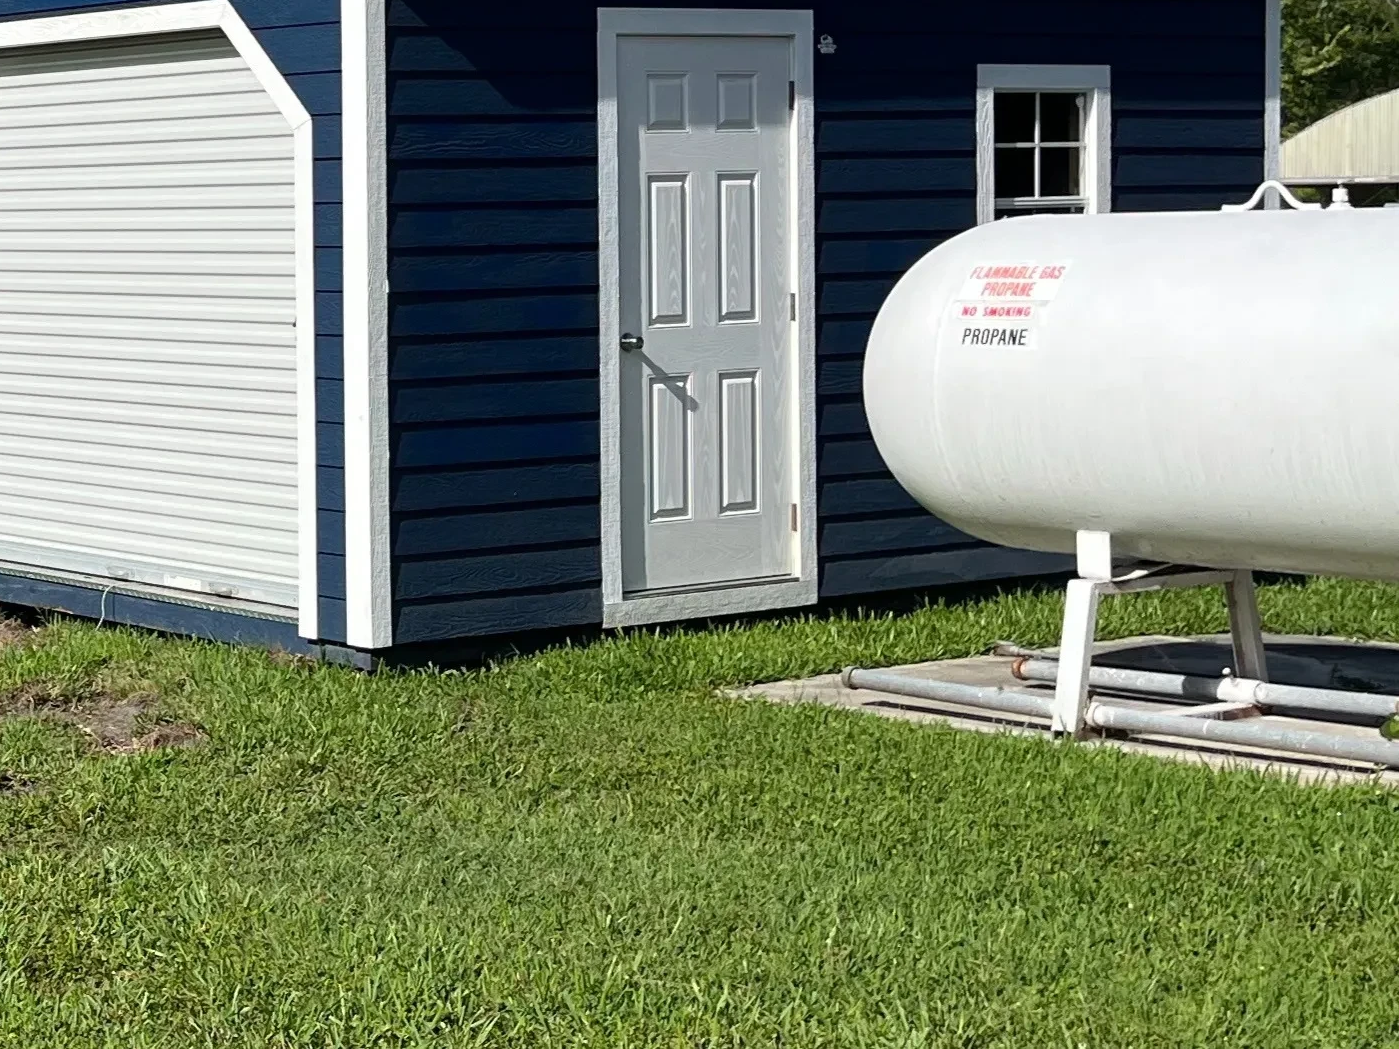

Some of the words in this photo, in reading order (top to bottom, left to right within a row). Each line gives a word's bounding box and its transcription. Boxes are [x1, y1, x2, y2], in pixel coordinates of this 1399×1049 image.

[970, 266, 1038, 279] FLAMMABLE
[1039, 266, 1065, 279] GAS
[981, 282, 1036, 296] PROPANE
[962, 307, 977, 316] NO
[983, 306, 1031, 317] SMOKING
[962, 328, 1028, 345] PROPANE
